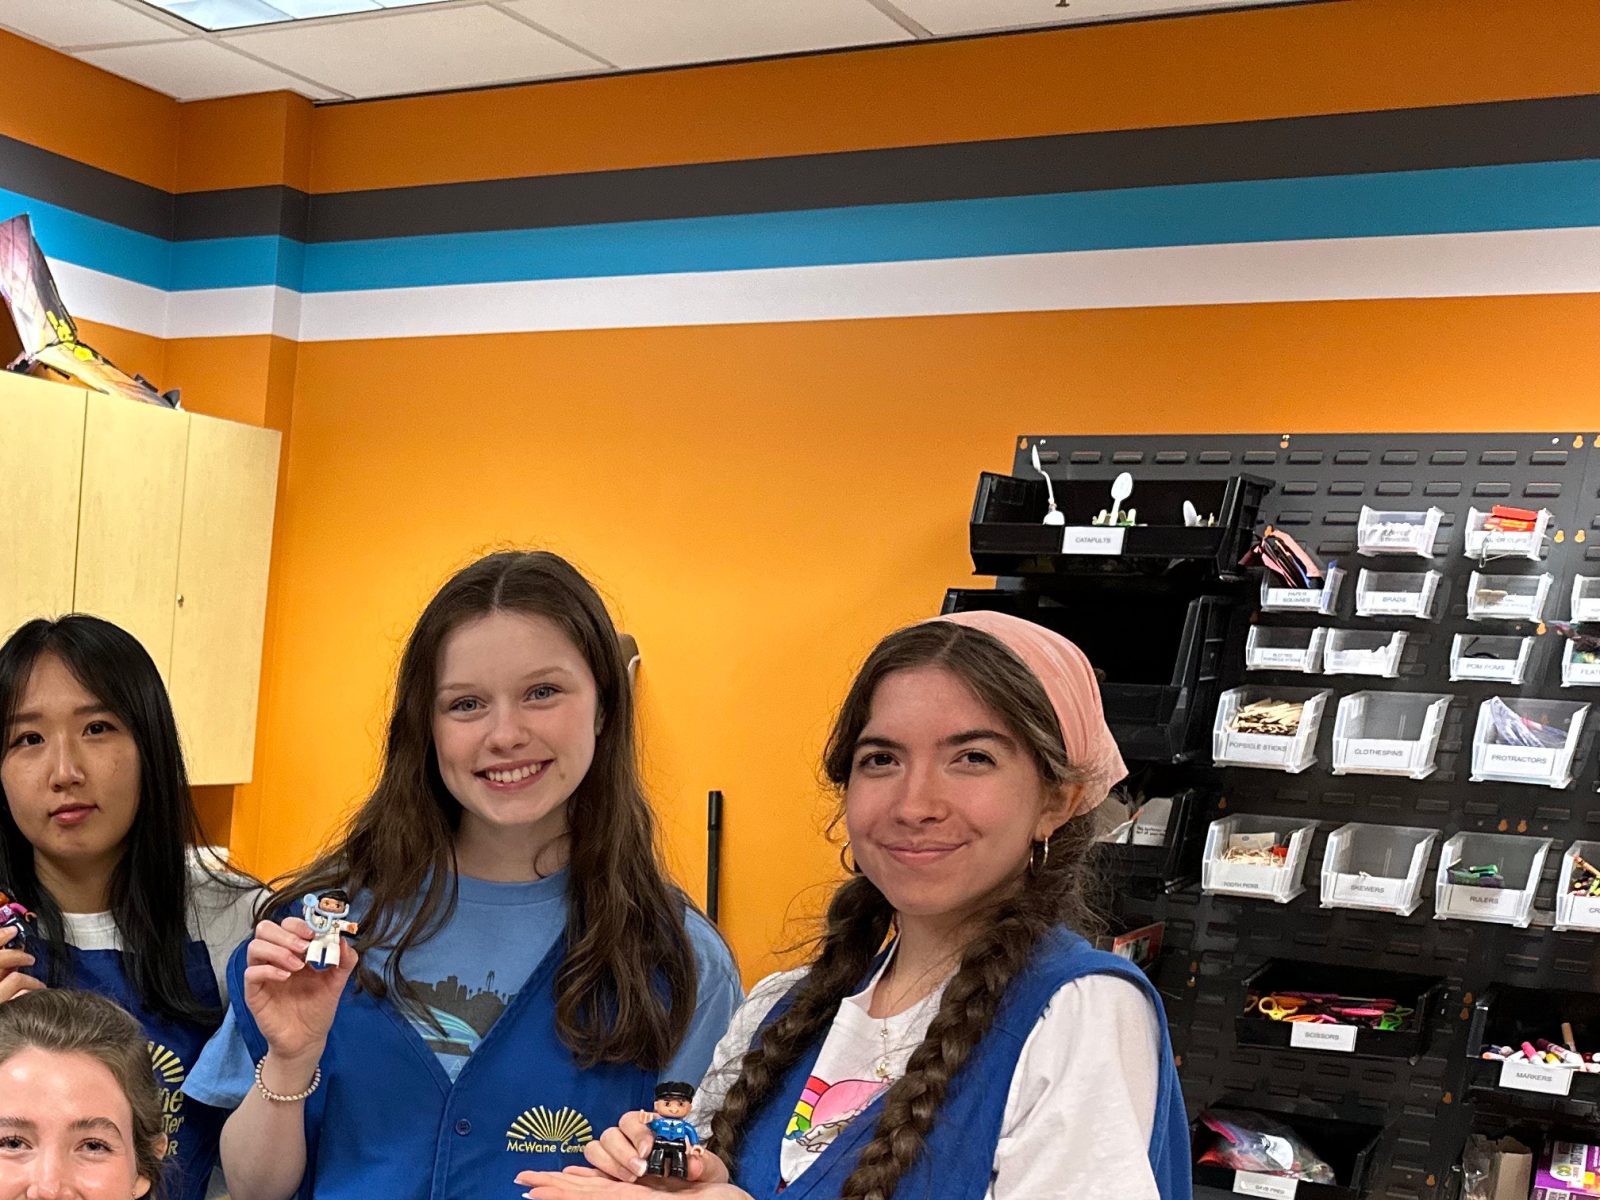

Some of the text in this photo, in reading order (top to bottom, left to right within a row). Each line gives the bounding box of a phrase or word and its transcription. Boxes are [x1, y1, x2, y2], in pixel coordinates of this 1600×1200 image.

[1229, 742, 1261, 750] POPSICLE
[1354, 748, 1404, 757] CLOTHESPINS
[1491, 754, 1547, 764] PROTRACTORS
[1350, 885, 1385, 894] SKEWERS
[1469, 896, 1499, 905] RULERS
[1304, 1032, 1340, 1040] SCISSORS
[1516, 1072, 1553, 1082] MARKERS
[506, 1140, 557, 1153] McWane
